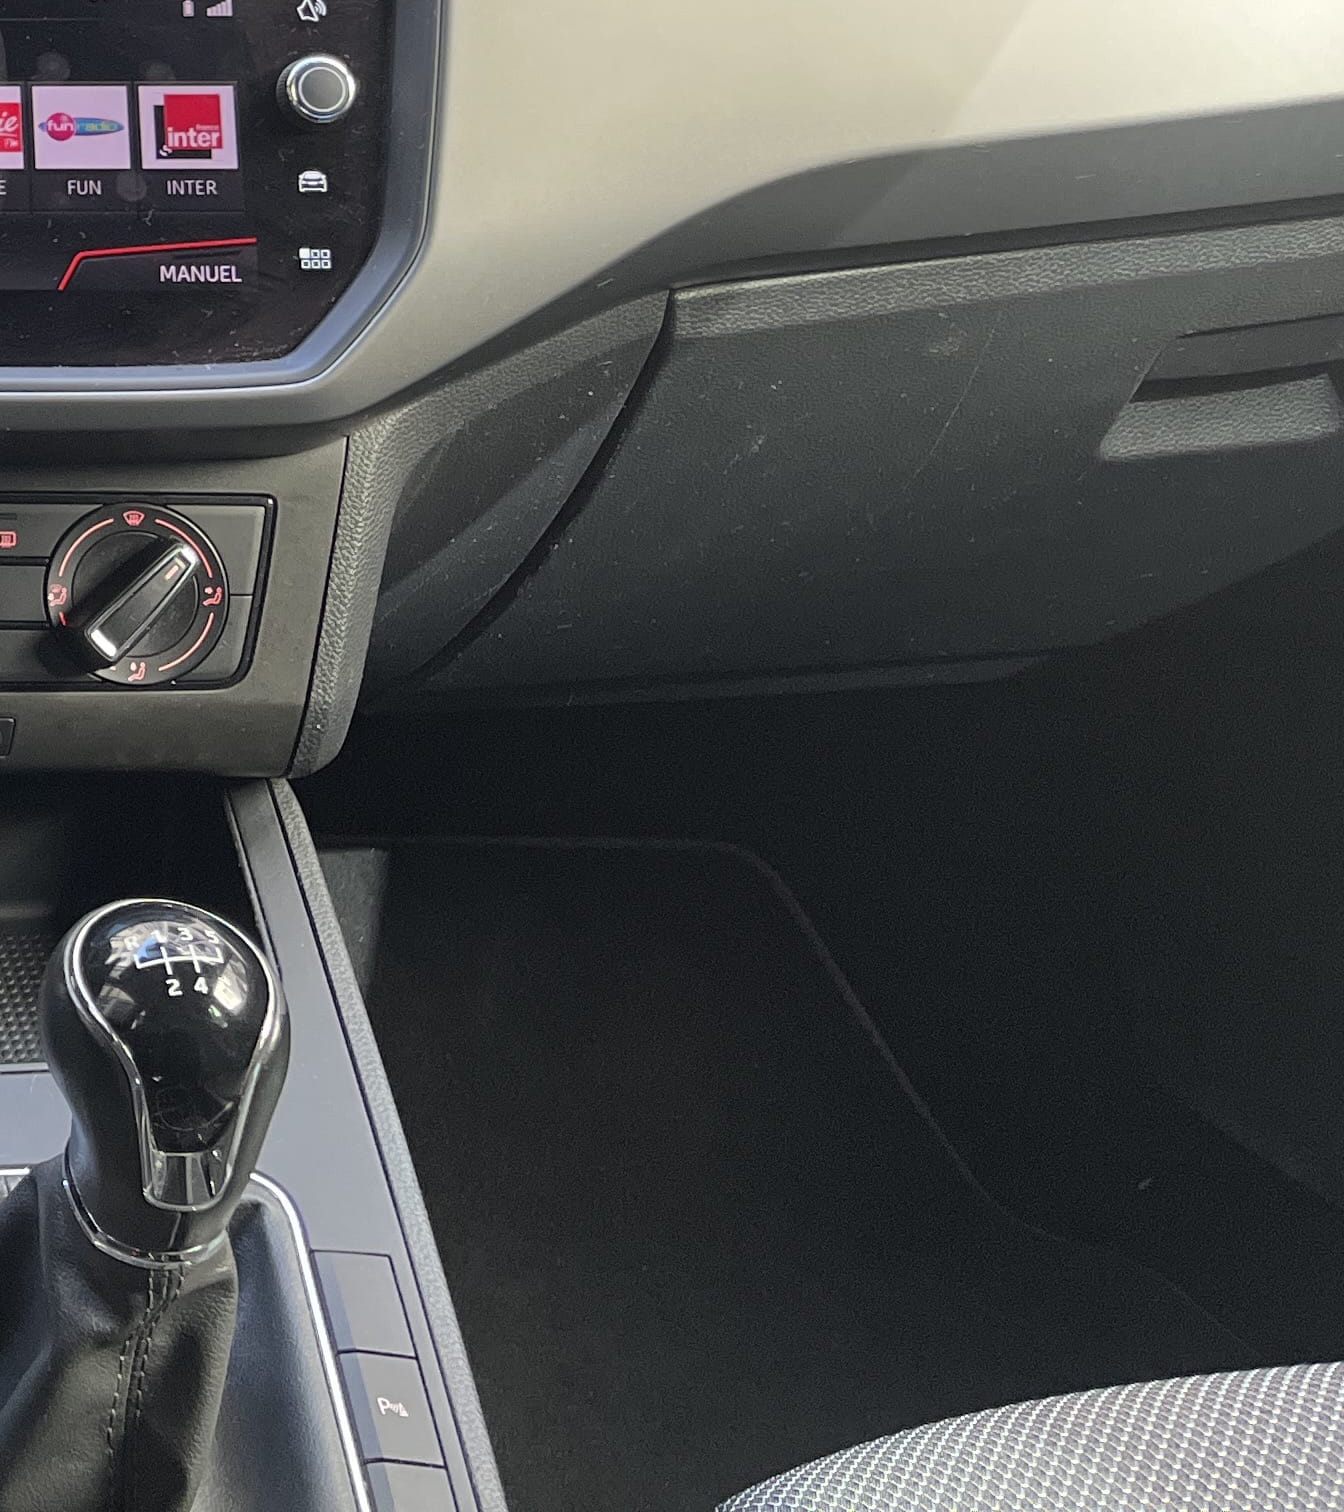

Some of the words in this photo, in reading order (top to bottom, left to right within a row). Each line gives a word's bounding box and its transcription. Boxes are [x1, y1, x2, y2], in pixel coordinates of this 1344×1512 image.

[167, 126, 220, 148] inter
[67, 179, 102, 195] FUN
[166, 179, 218, 195] INTER
[159, 265, 243, 283] MANUEL
[177, 927, 194, 941] 3
[165, 978, 183, 997] 2
[194, 976, 209, 995] 4
